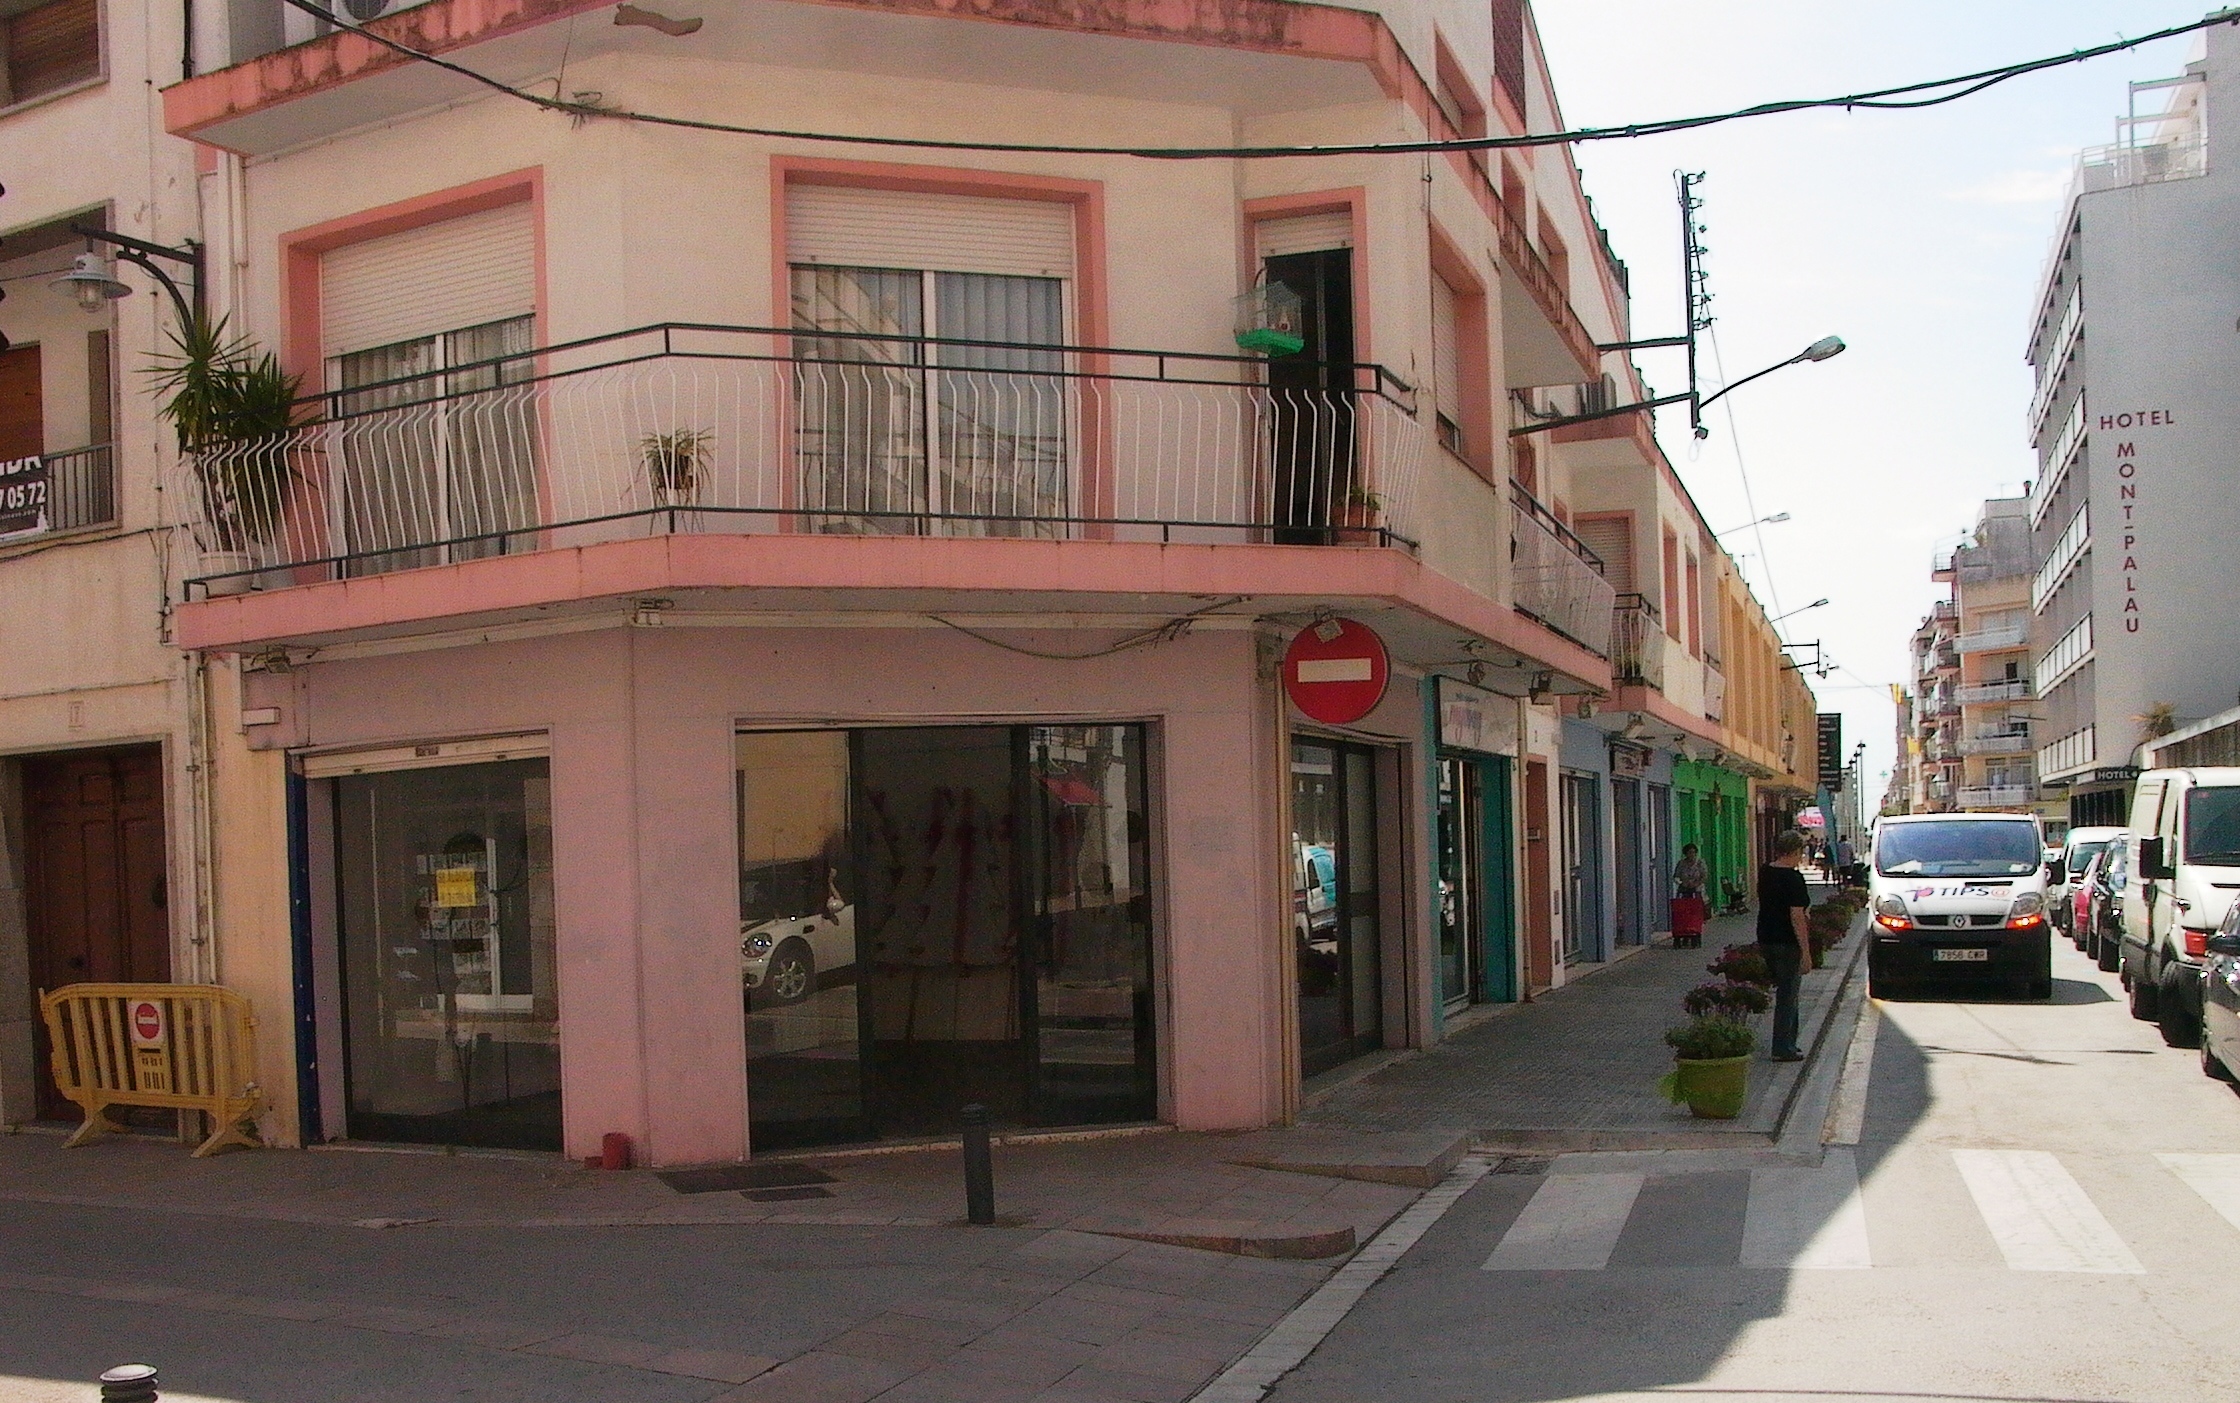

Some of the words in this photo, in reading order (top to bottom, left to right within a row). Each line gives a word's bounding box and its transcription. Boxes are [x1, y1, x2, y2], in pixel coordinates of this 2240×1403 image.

[2100, 410, 2174, 430] HOTEL
[2116, 442, 2139, 633] MONT-PALAU
[2097, 770, 2131, 780] HOTEL
